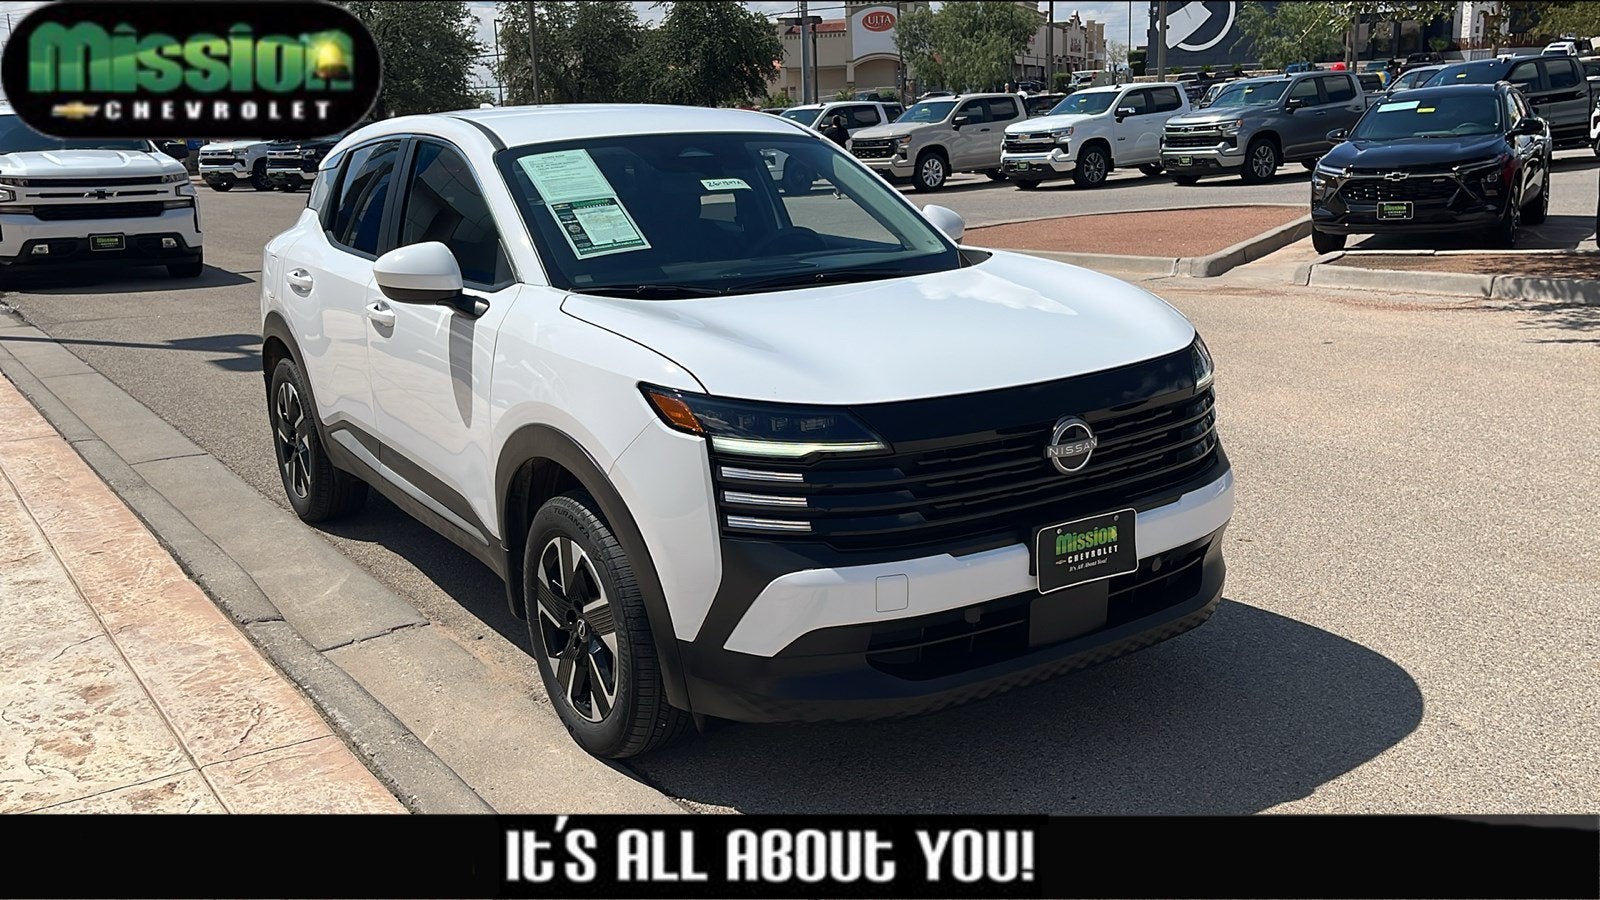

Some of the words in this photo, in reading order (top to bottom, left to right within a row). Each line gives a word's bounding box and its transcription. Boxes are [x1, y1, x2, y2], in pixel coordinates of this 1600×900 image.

[1049, 439, 1097, 456] NISSAN
[554, 507, 590, 539] TURANZA
[1056, 526, 1118, 556] Mission
[1067, 544, 1118, 563] CHEVROLET
